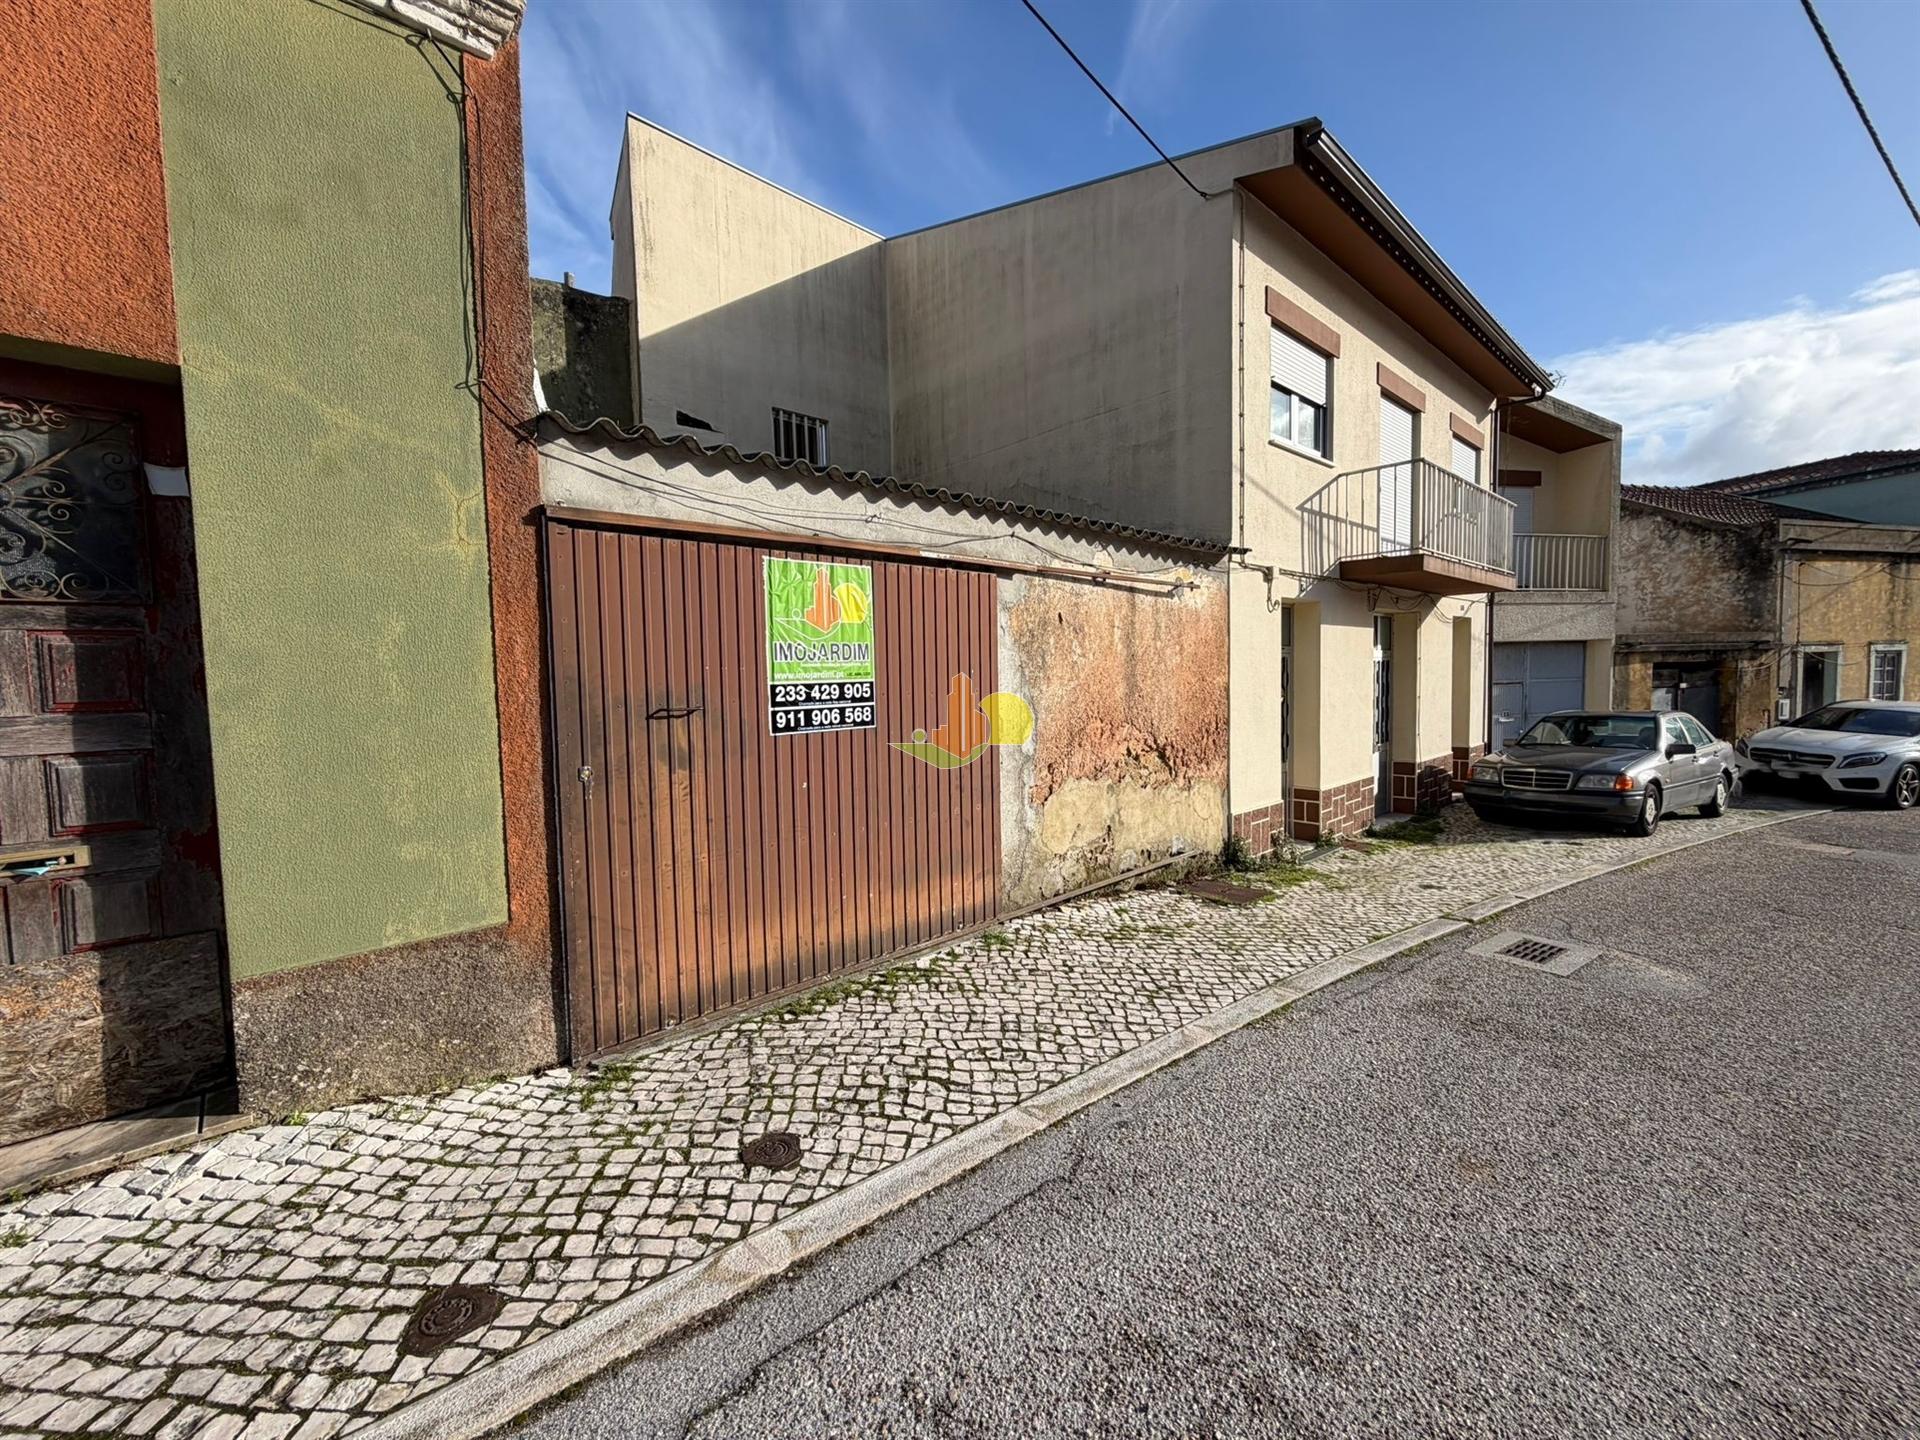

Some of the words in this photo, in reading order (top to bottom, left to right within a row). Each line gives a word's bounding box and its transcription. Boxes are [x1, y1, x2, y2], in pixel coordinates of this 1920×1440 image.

[774, 642, 869, 661] IMOJARDIM
[775, 685, 806, 702] 233
[811, 684, 840, 700] 429
[844, 683, 871, 699] 905
[776, 710, 805, 728] 911
[811, 708, 840, 726] 906
[844, 706, 872, 723] 568
